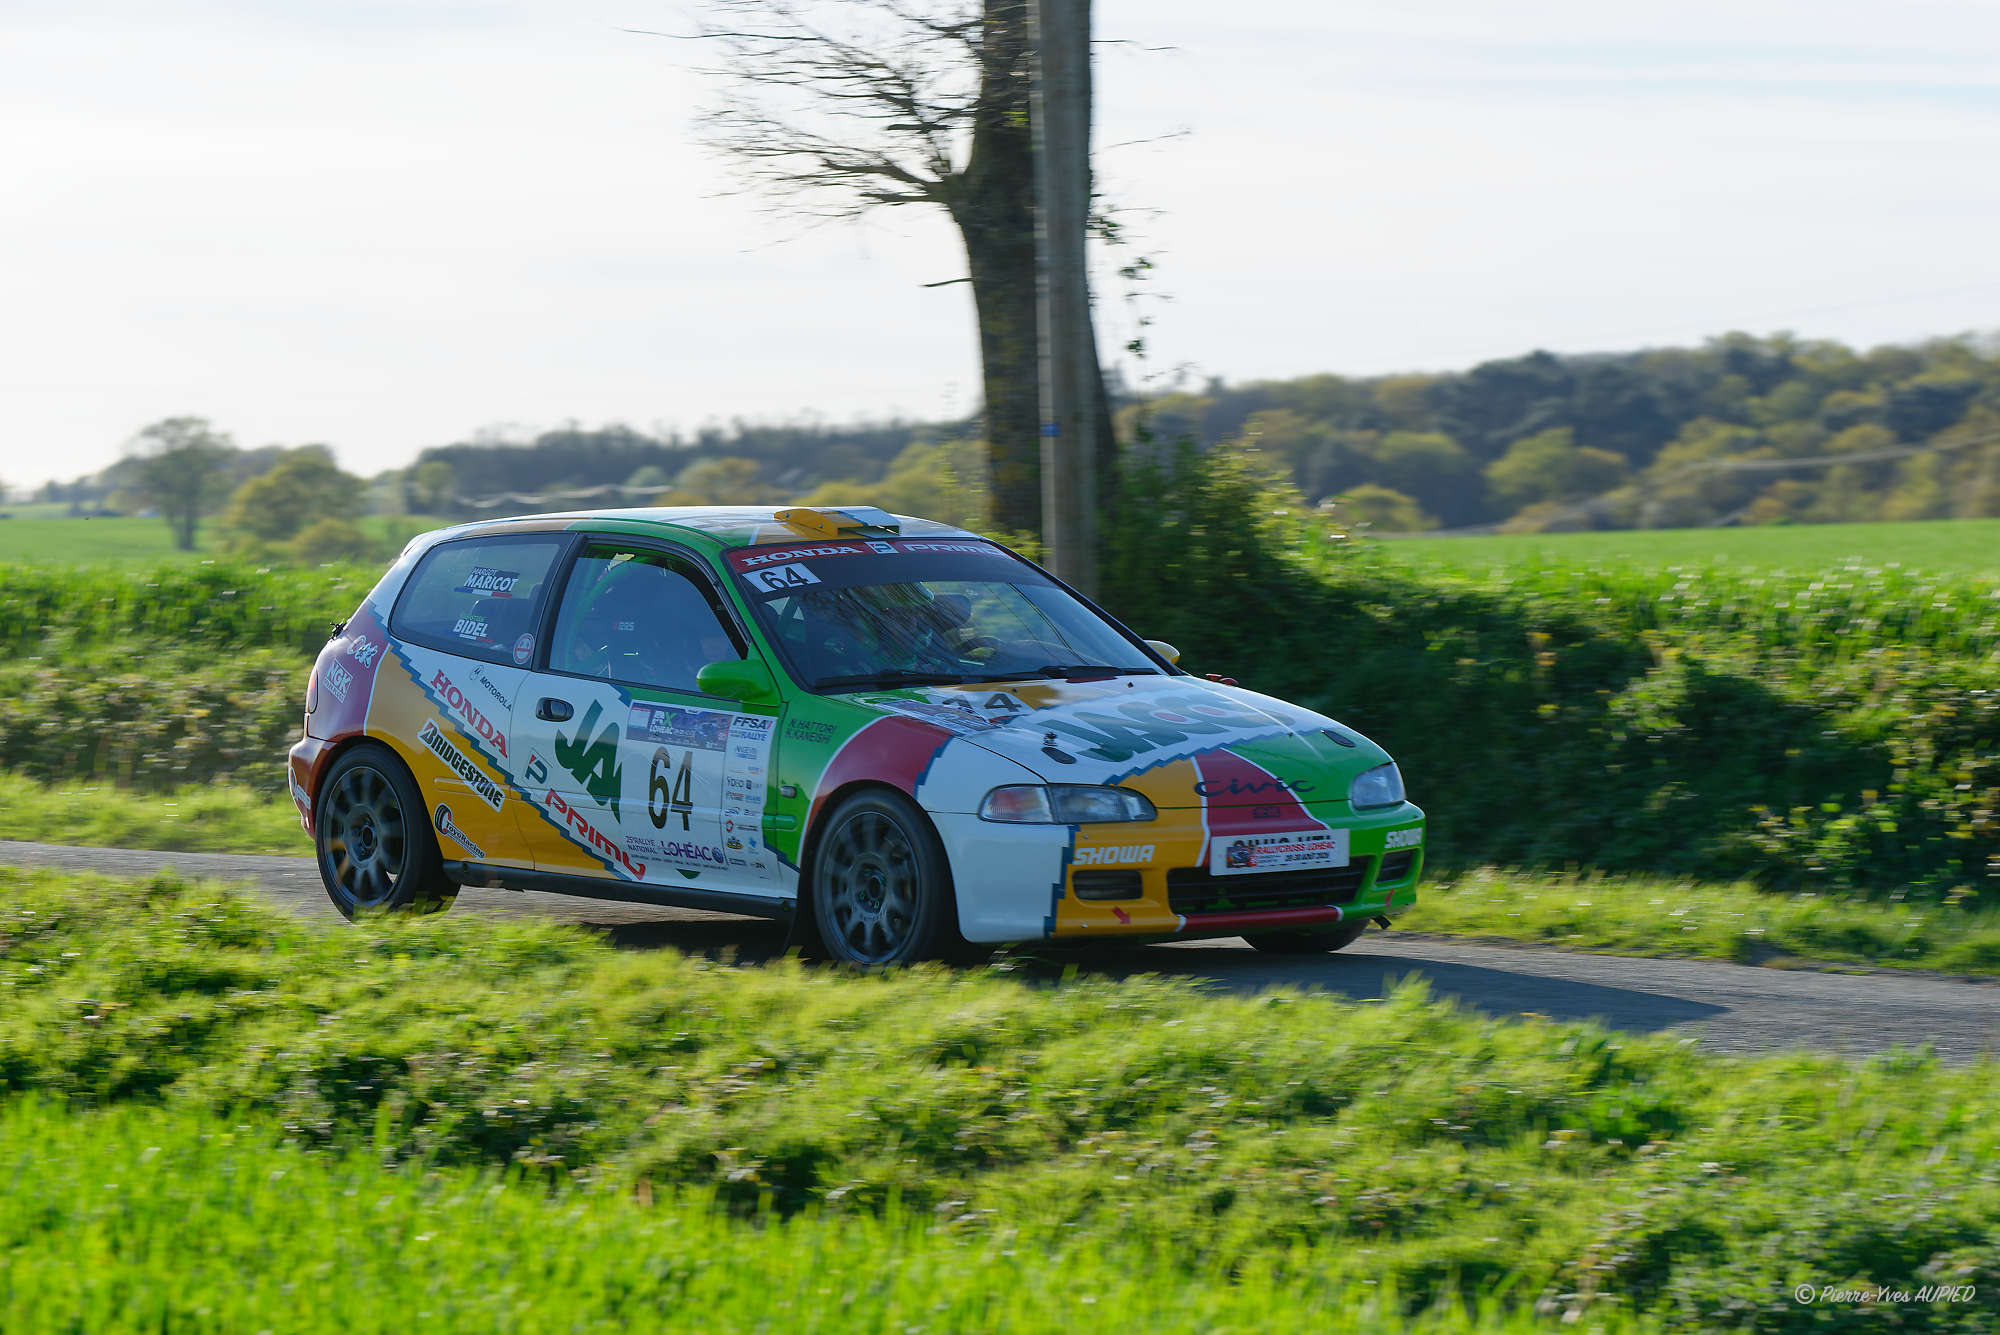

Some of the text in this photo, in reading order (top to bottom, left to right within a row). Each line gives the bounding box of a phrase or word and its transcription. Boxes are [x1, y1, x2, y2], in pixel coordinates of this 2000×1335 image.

[743, 546, 863, 566] HONDA
[464, 574, 519, 592] MARICOT
[759, 565, 809, 590] 64
[453, 619, 489, 638] BIDEL
[327, 661, 352, 694] NGK
[480, 674, 512, 713] MOTOROLA
[430, 668, 509, 760] HONDA
[732, 716, 768, 729] FFSA
[741, 730, 768, 742] RALLYE
[419, 721, 504, 807] BRIDGESTONE
[648, 746, 693, 831] 64
[1194, 777, 1315, 797] Civic
[1384, 828, 1423, 849] SHOWA
[661, 841, 713, 862] LOHÉAC
[1073, 844, 1155, 866] SHOWA
